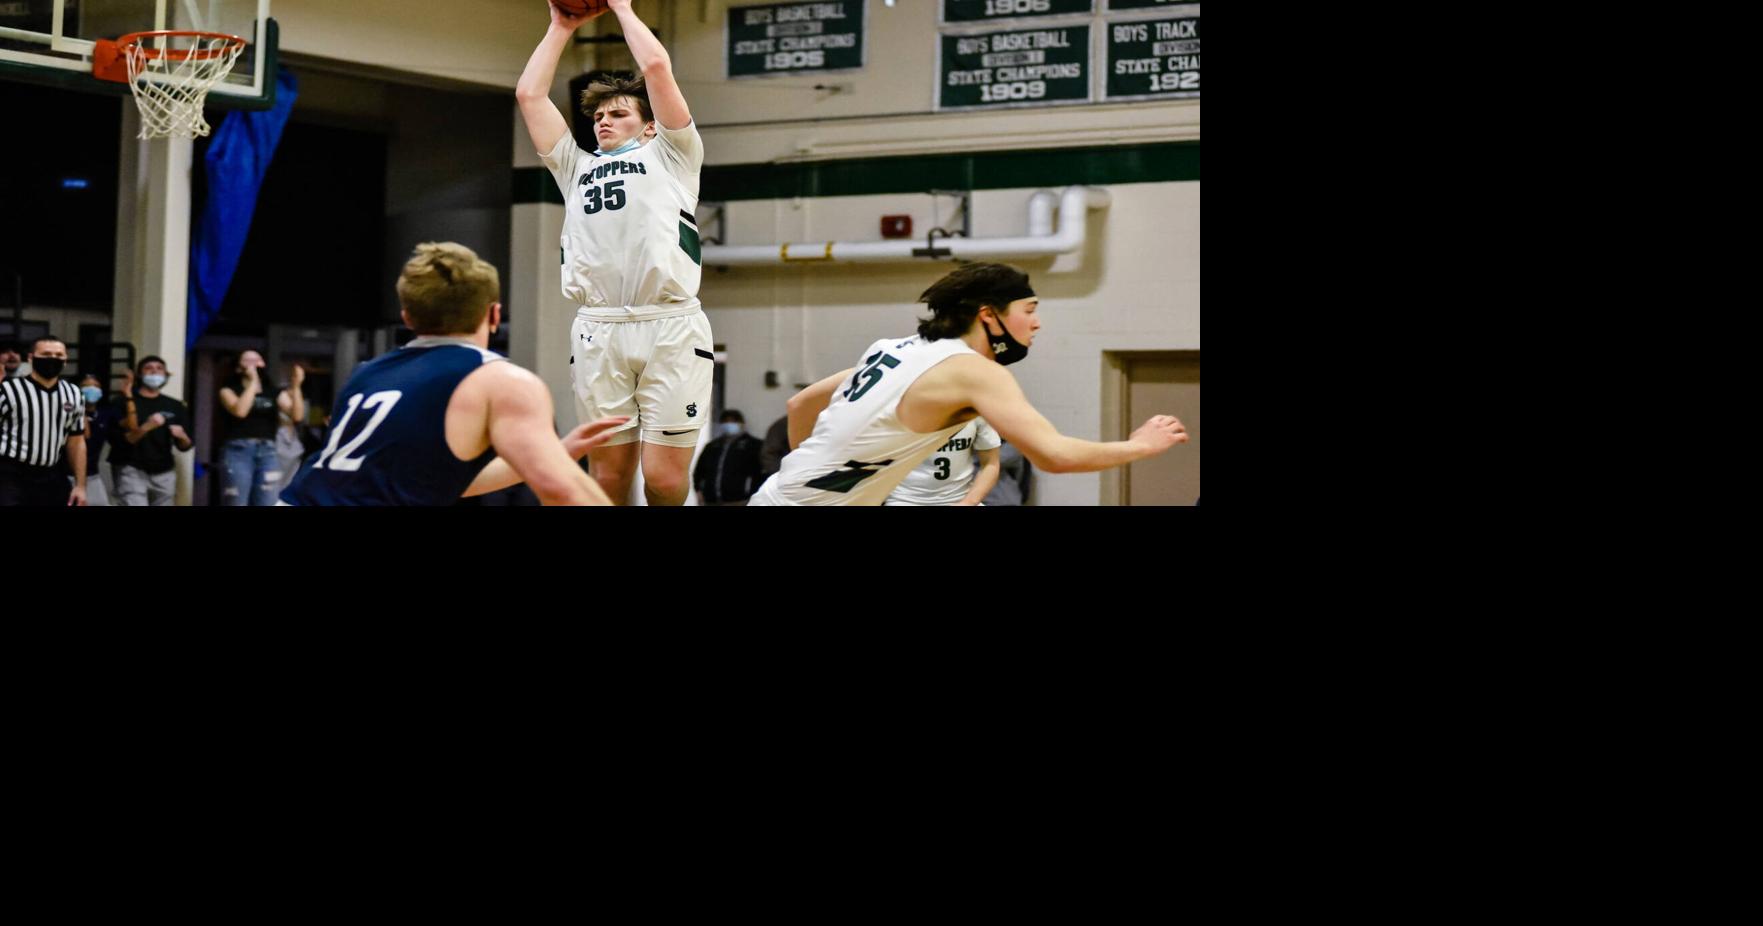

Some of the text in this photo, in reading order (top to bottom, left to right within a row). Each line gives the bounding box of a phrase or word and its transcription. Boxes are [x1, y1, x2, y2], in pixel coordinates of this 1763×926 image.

[992, 30, 1070, 52] BASKETBALL
[1113, 20, 1196, 43] BOYS TRACK
[735, 33, 856, 55] STATE CHAMPIONS
[947, 63, 1081, 85] STATE CHAMPIONS
[1115, 55, 1200, 74] STATE CHA
[981, 81, 1047, 102] 1909
[1149, 71, 1200, 91] 192
[584, 180, 627, 215] 35
[843, 350, 902, 403] 15
[312, 390, 403, 472] 12
[934, 457, 951, 481] 3
